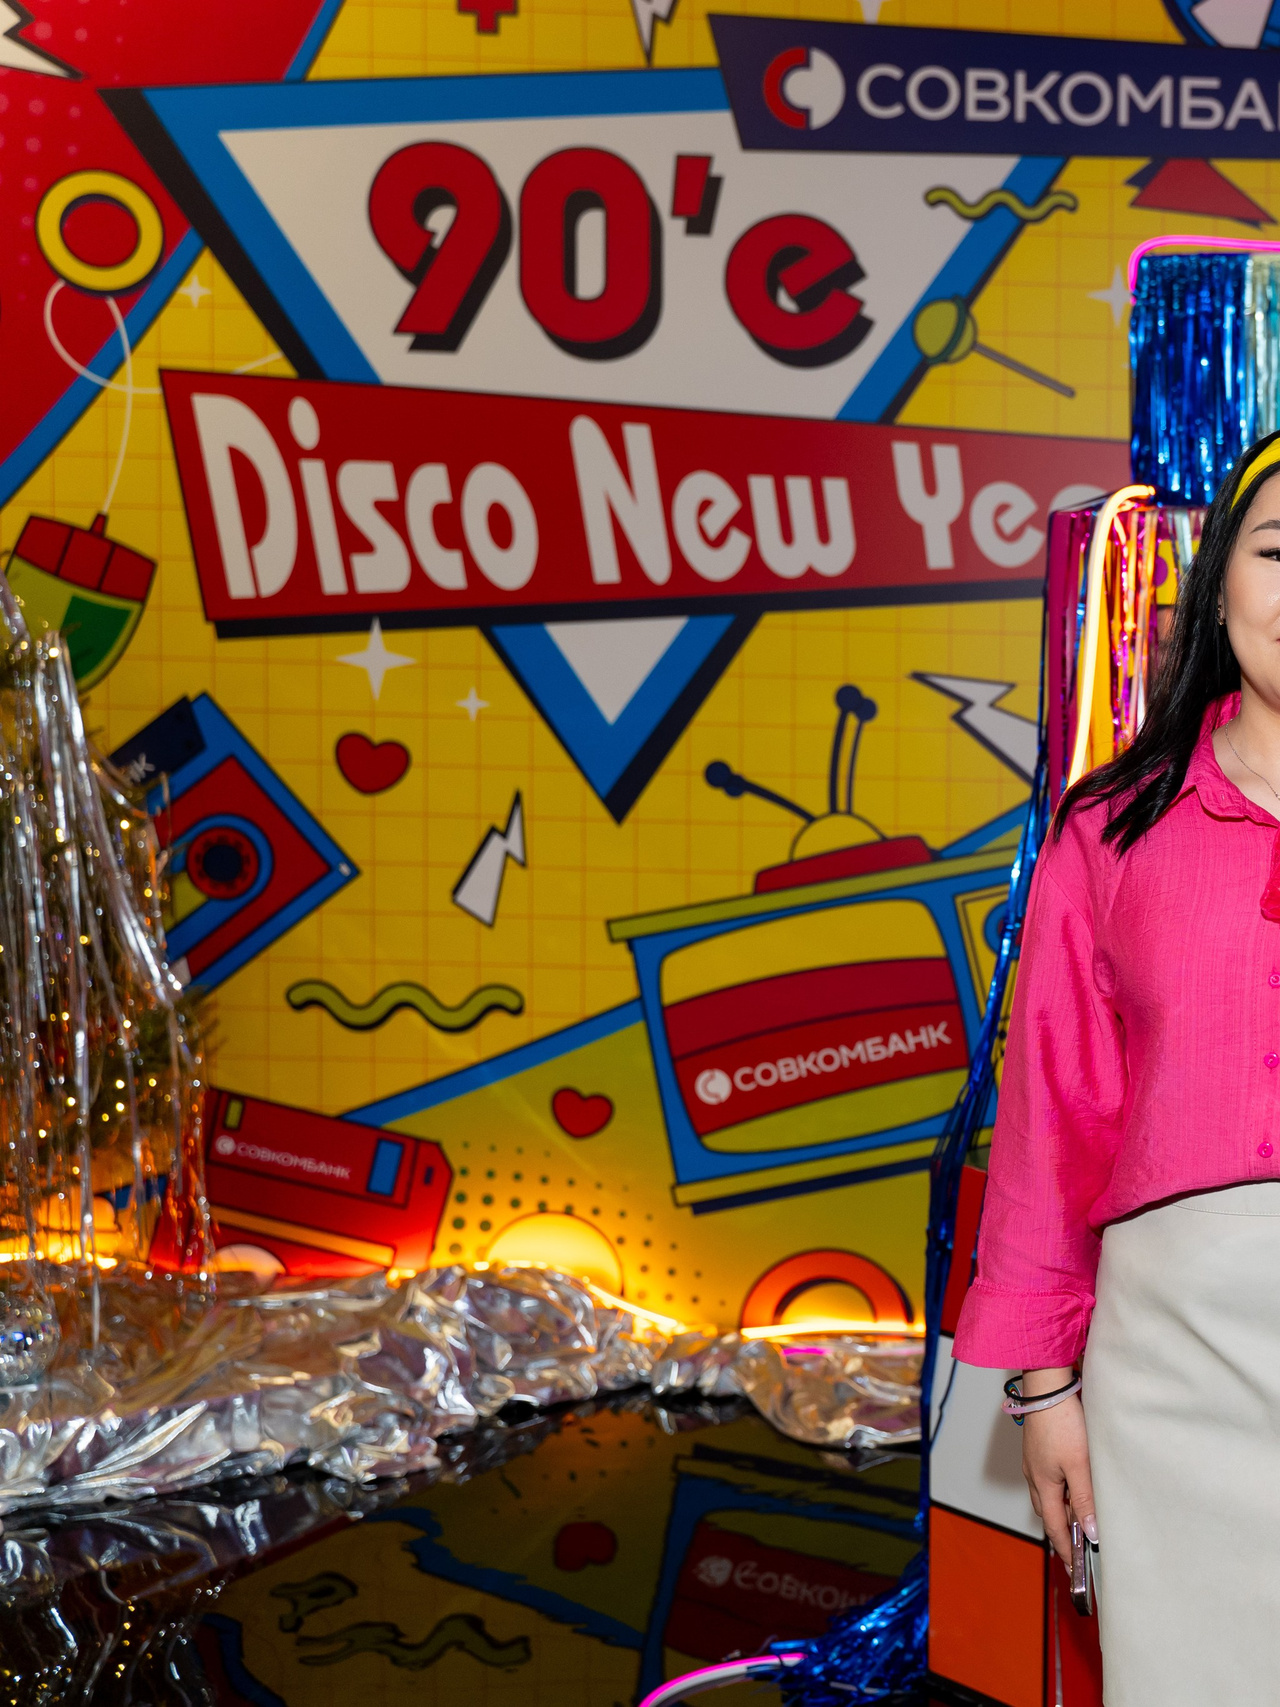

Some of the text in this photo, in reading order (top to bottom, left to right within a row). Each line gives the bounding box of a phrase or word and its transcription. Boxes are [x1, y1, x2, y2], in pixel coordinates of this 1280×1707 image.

[190, 392, 1110, 599] Disco New Ye
[733, 1021, 952, 1092] СОВКОМБАНК
[236, 1142, 351, 1180] СОВКОМБАНК
